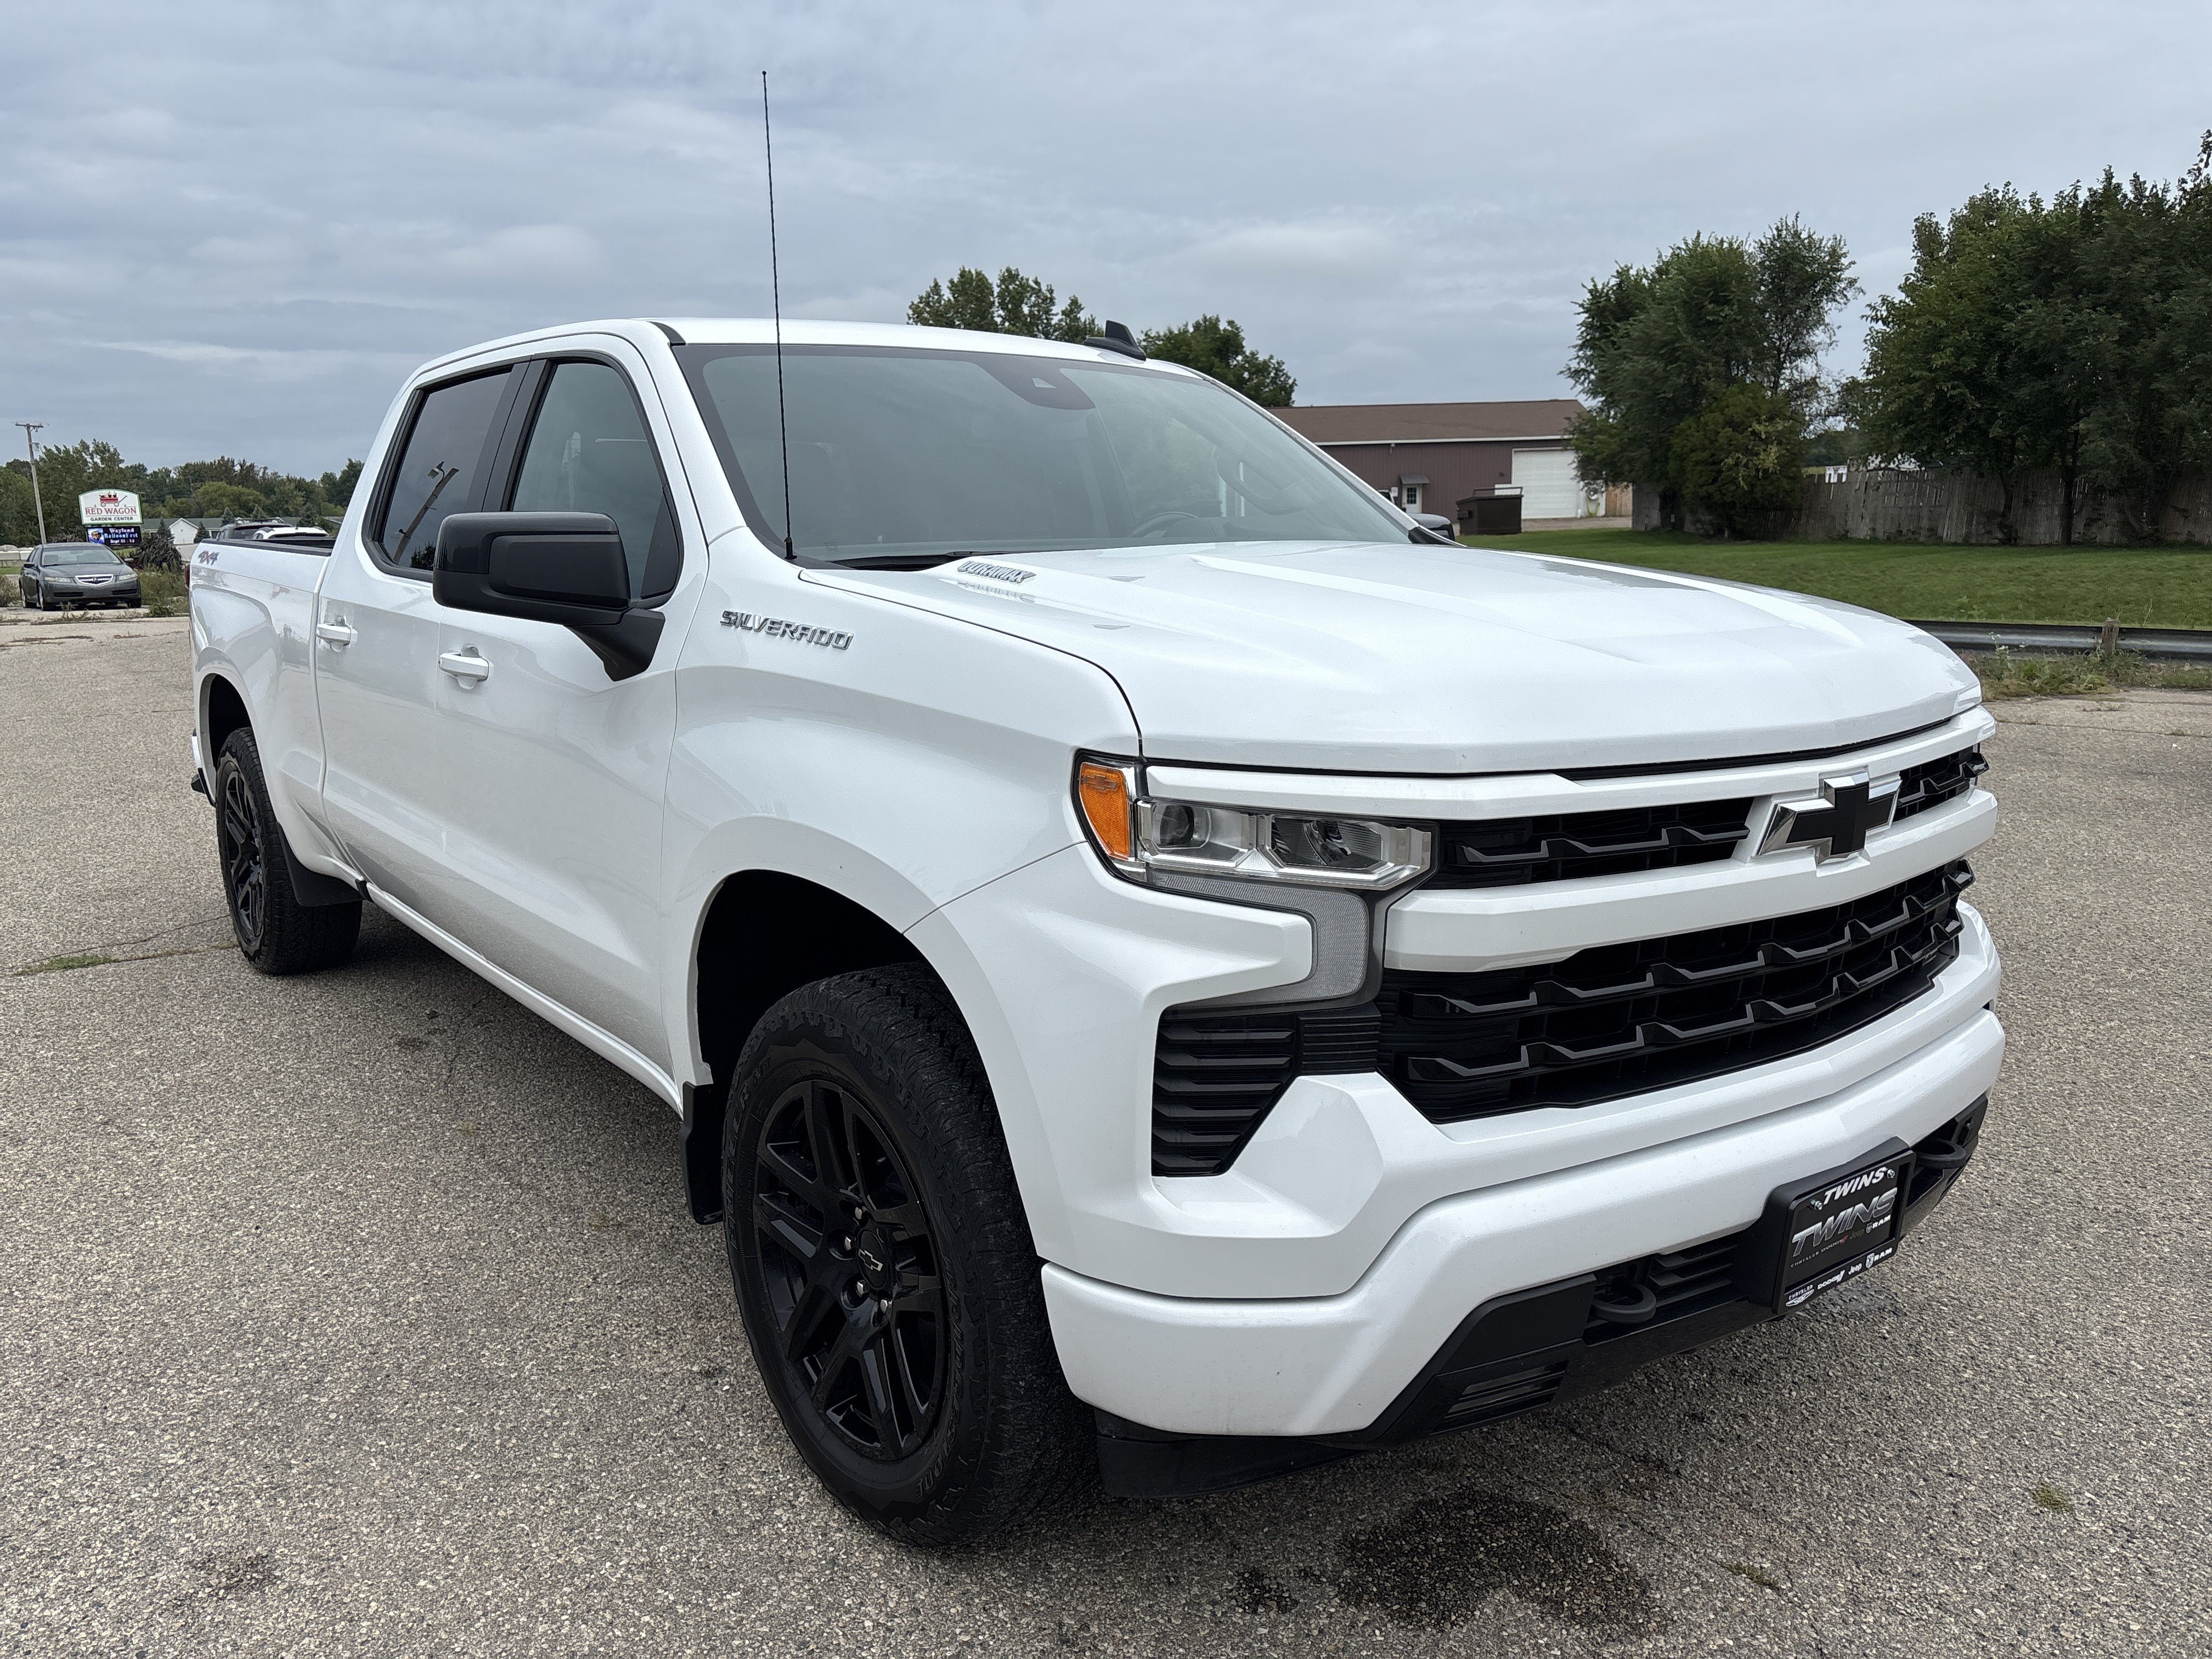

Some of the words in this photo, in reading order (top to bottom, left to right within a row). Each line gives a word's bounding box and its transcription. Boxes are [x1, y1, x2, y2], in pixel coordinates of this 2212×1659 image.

[957, 560, 1036, 583] DURAMAX
[720, 610, 854, 650] SILVERADO
[726, 1082, 752, 1251] DUELER
[1822, 1166, 1888, 1205] TWINS
[1790, 1251, 1819, 1268] CHRYSLER
[1849, 1228, 1865, 1240] Jeep
[1872, 1214, 1891, 1229] RAM
[1791, 1187, 1898, 1257] TWINS
[1788, 1284, 1813, 1300] CHRYSLER
[1817, 1273, 1841, 1290] DODGE
[1848, 1263, 1863, 1275] Jeep
[1874, 1247, 1893, 1261] RAM
